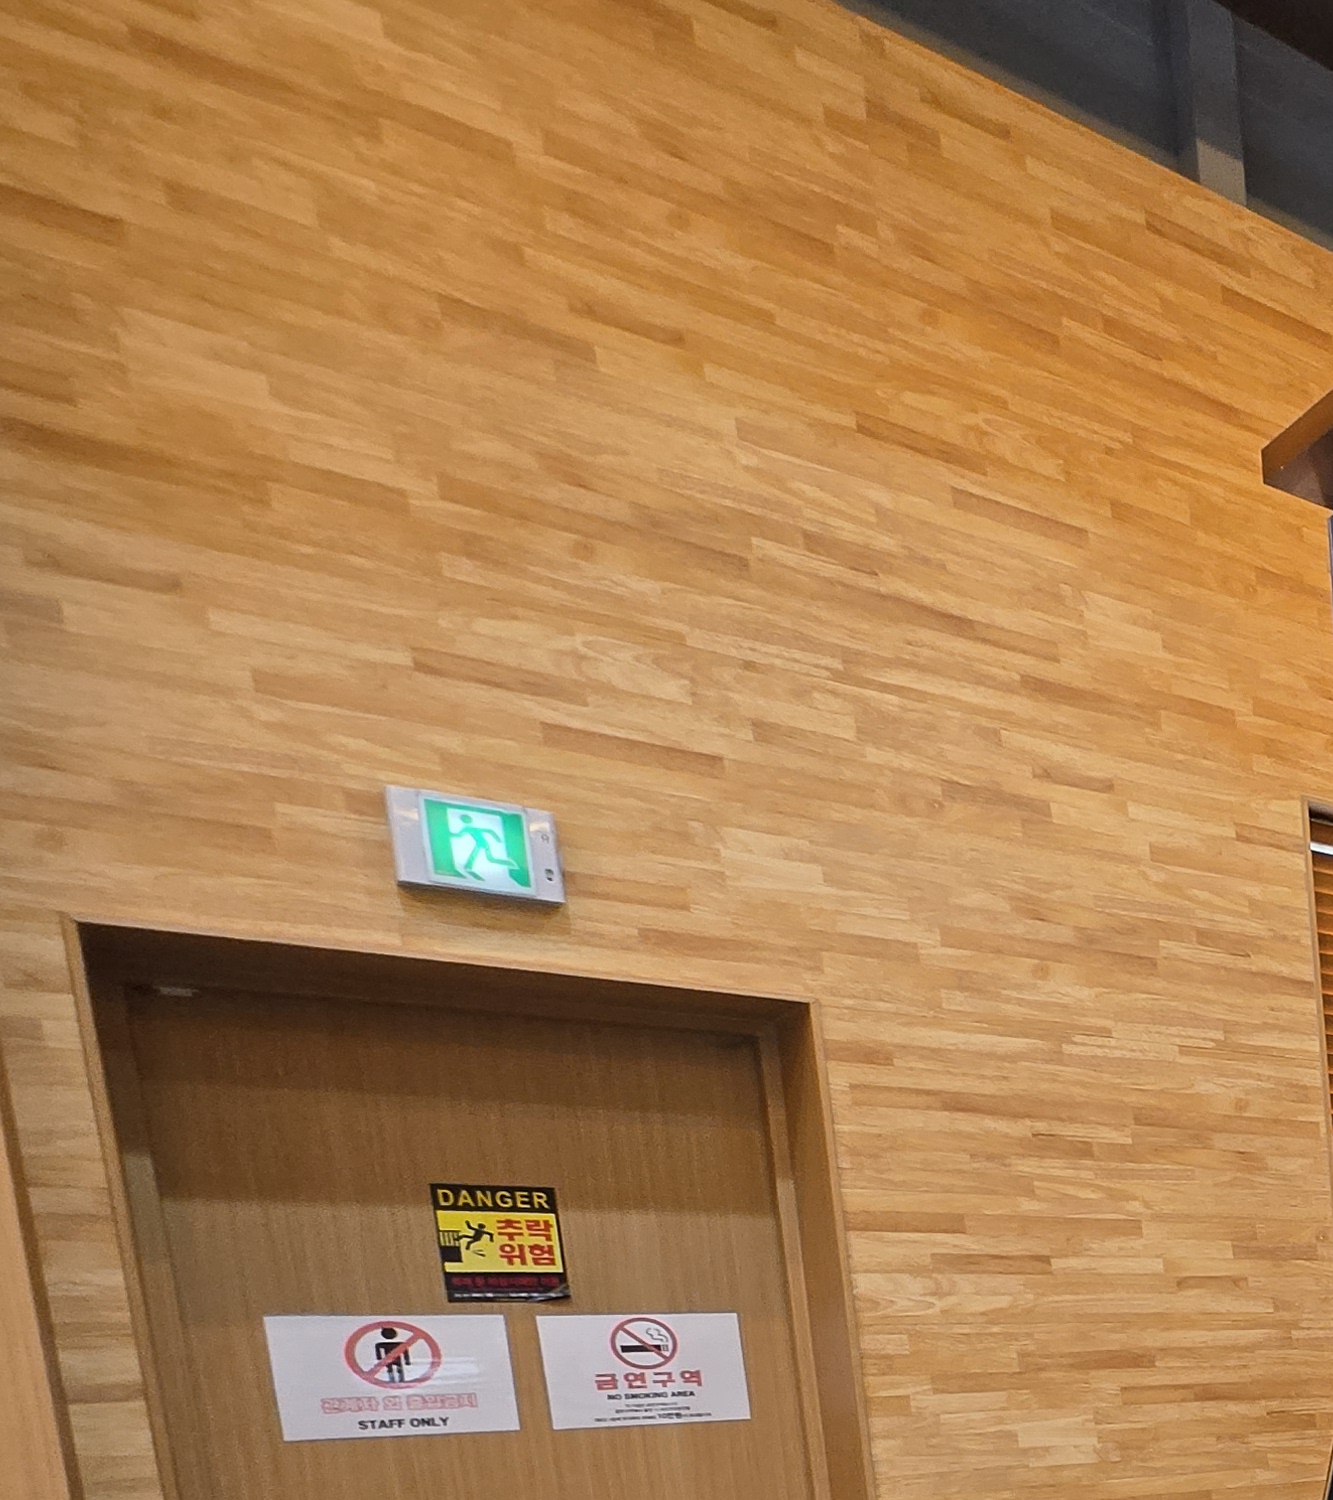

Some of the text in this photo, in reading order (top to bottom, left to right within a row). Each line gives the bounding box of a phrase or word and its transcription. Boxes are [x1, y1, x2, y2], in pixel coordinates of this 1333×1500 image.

[436, 1188, 551, 1210] DANGER
[496, 1218, 553, 1242] 추락
[499, 1243, 556, 1266] 위험
[595, 1370, 703, 1390] 금연구역
[624, 1391, 668, 1399] SMOKING
[358, 1416, 450, 1430] STAFF ONLY
